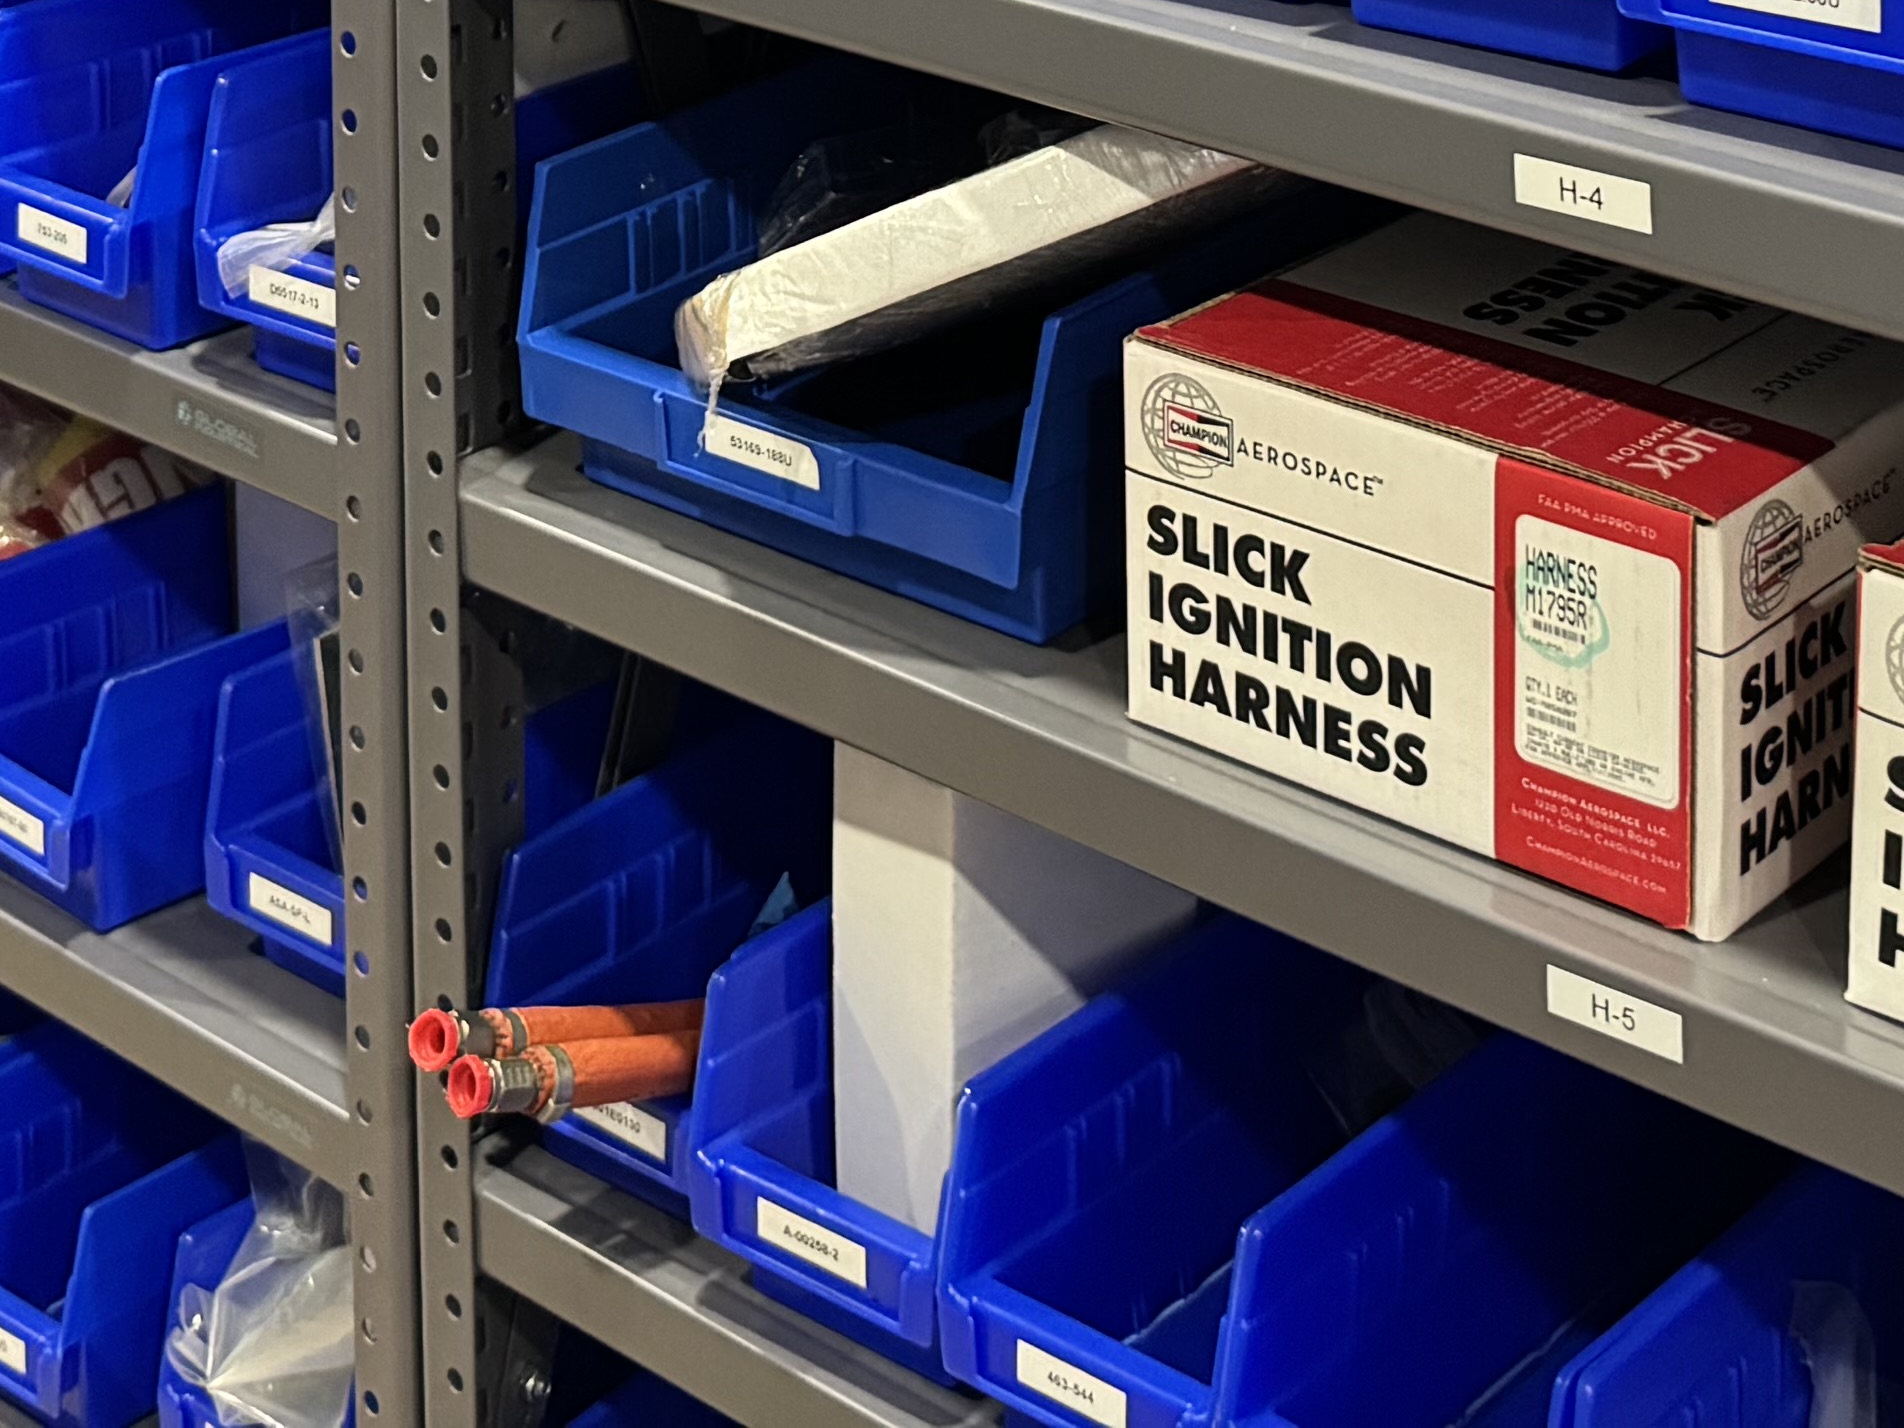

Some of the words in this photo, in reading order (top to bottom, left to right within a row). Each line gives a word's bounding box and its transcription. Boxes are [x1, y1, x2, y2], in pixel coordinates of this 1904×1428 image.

[1559, 178, 1604, 210] H-4
[1170, 420, 1228, 450] CHAMPION
[1146, 504, 1312, 606] SLICK
[1525, 544, 1598, 600] HARNESS
[1148, 571, 1432, 720] IGNITION
[1525, 583, 1588, 630] M1795R
[1554, 682, 1578, 706] EACH
[1739, 601, 1848, 726] SLICK
[1149, 639, 1428, 787] HARNESS
[1740, 666, 1855, 803] IGNITI
[1739, 744, 1851, 877] HARN
[1592, 993, 1636, 1031] H-5
